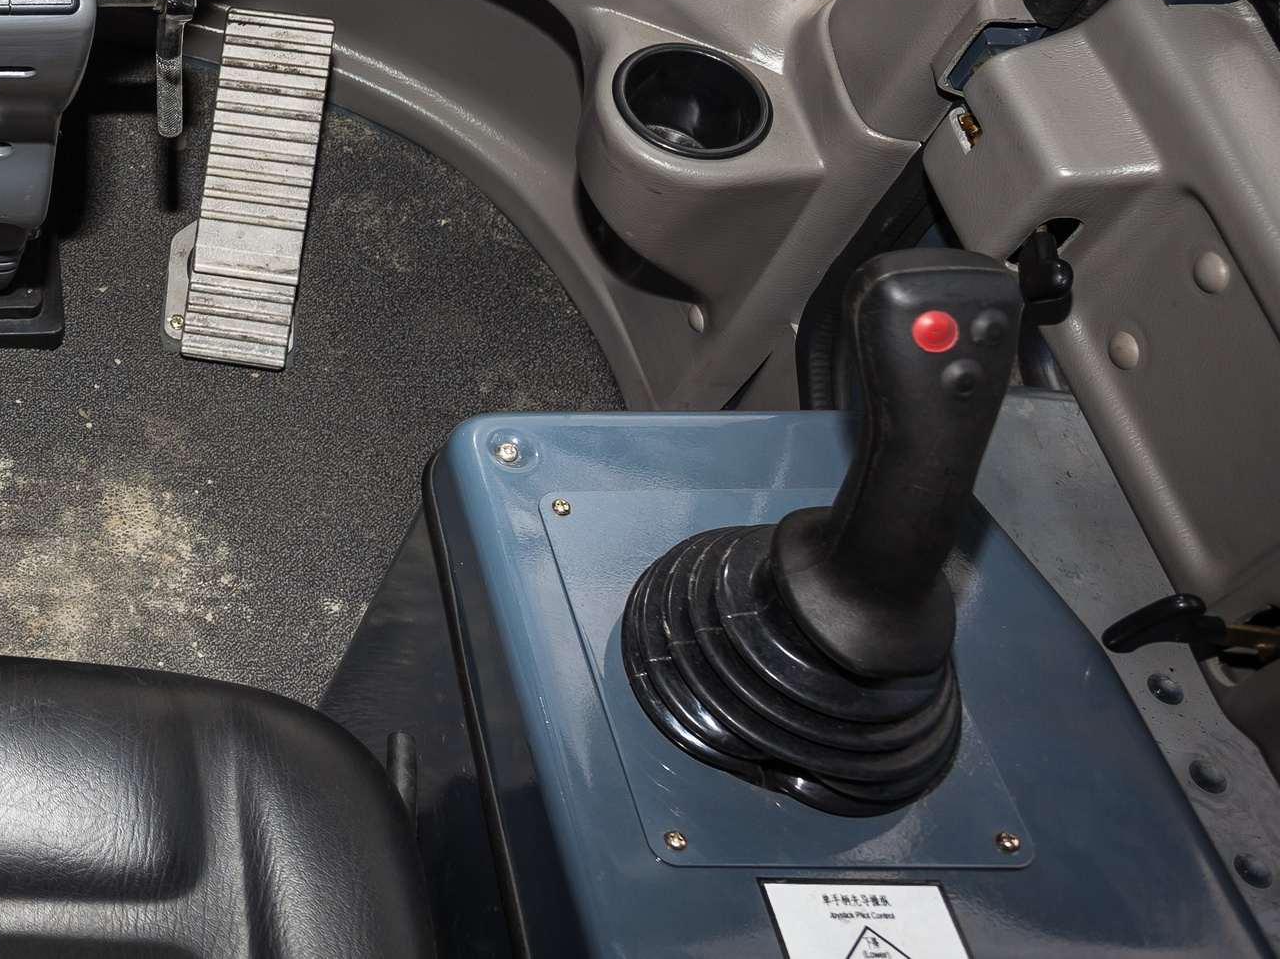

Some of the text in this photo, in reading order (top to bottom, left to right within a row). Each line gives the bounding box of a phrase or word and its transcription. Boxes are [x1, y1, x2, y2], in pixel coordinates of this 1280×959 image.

[830, 911, 895, 920] Joystick Pilot Control
